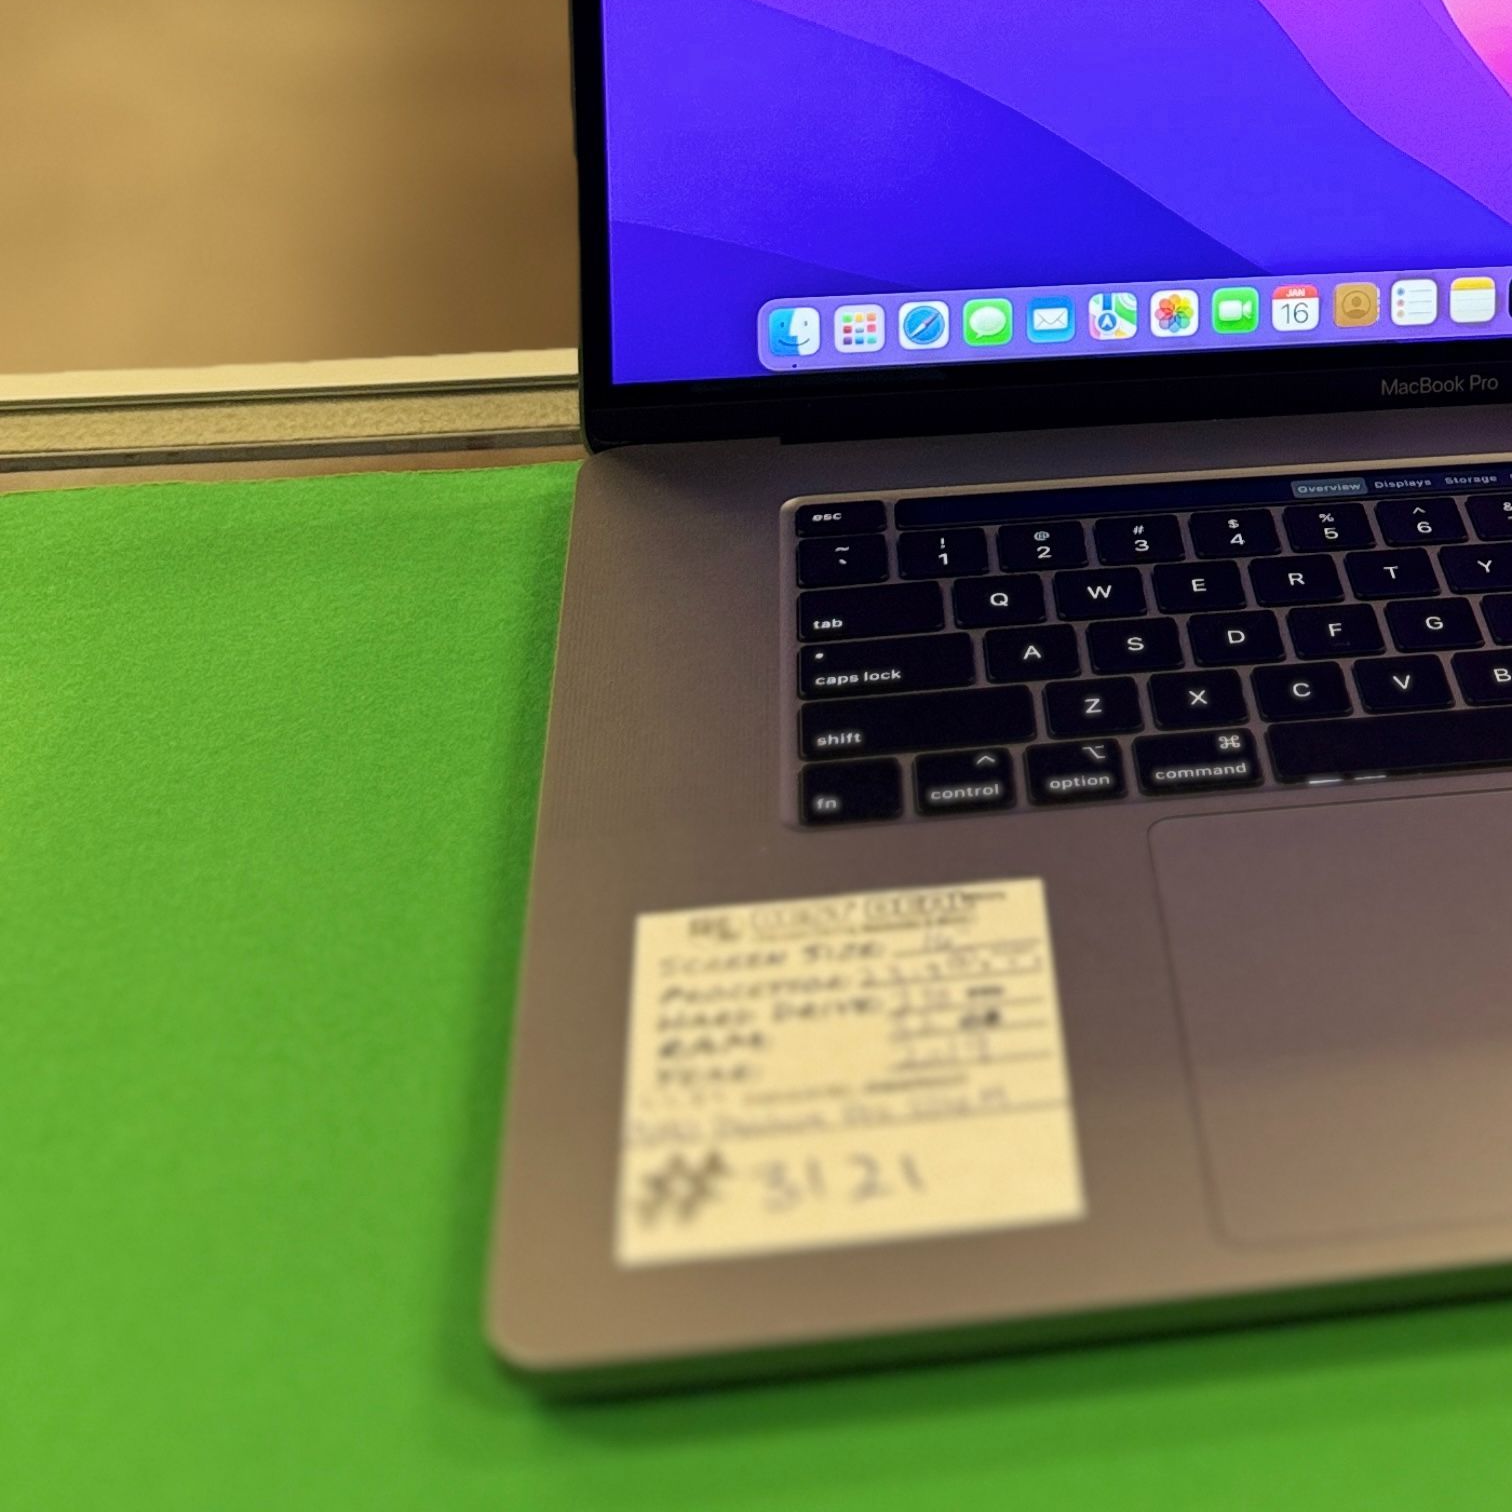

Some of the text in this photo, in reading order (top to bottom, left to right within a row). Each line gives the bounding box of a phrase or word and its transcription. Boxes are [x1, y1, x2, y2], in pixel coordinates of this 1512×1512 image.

[1286, 288, 1305, 297] JAN
[1281, 302, 1309, 324] 16
[1381, 374, 1499, 395] MacBook Pro
[1374, 478, 1431, 490] Displays
[1445, 475, 1497, 487] Storage
[1297, 481, 1361, 494] Overview
[813, 513, 841, 521] esc
[1324, 528, 1338, 539] 5
[1417, 522, 1432, 533] 6
[1231, 534, 1245, 544] 4
[1135, 540, 1149, 551] 3
[1037, 546, 1051, 558] 2
[939, 553, 947, 564] 1
[1384, 566, 1397, 578] T
[1478, 560, 1491, 572] Y
[1192, 579, 1206, 591] E
[1288, 573, 1304, 585] R
[1088, 585, 1111, 598] W
[990, 593, 1008, 606] Q
[814, 619, 842, 629] tab
[1426, 617, 1443, 629] G
[1329, 623, 1341, 636] F
[1228, 631, 1245, 643] D
[1128, 637, 1144, 650] S
[1024, 646, 1041, 659] A
[816, 670, 900, 685] caps lock
[1494, 669, 1511, 682] B
[1393, 675, 1410, 689] V
[1293, 683, 1310, 697] C
[1189, 690, 1207, 705] X
[1085, 698, 1101, 713] Z
[817, 733, 860, 746] shift
[1156, 763, 1246, 779] command
[1050, 776, 1110, 790] option
[931, 784, 999, 800] control
[816, 798, 836, 809] fn
